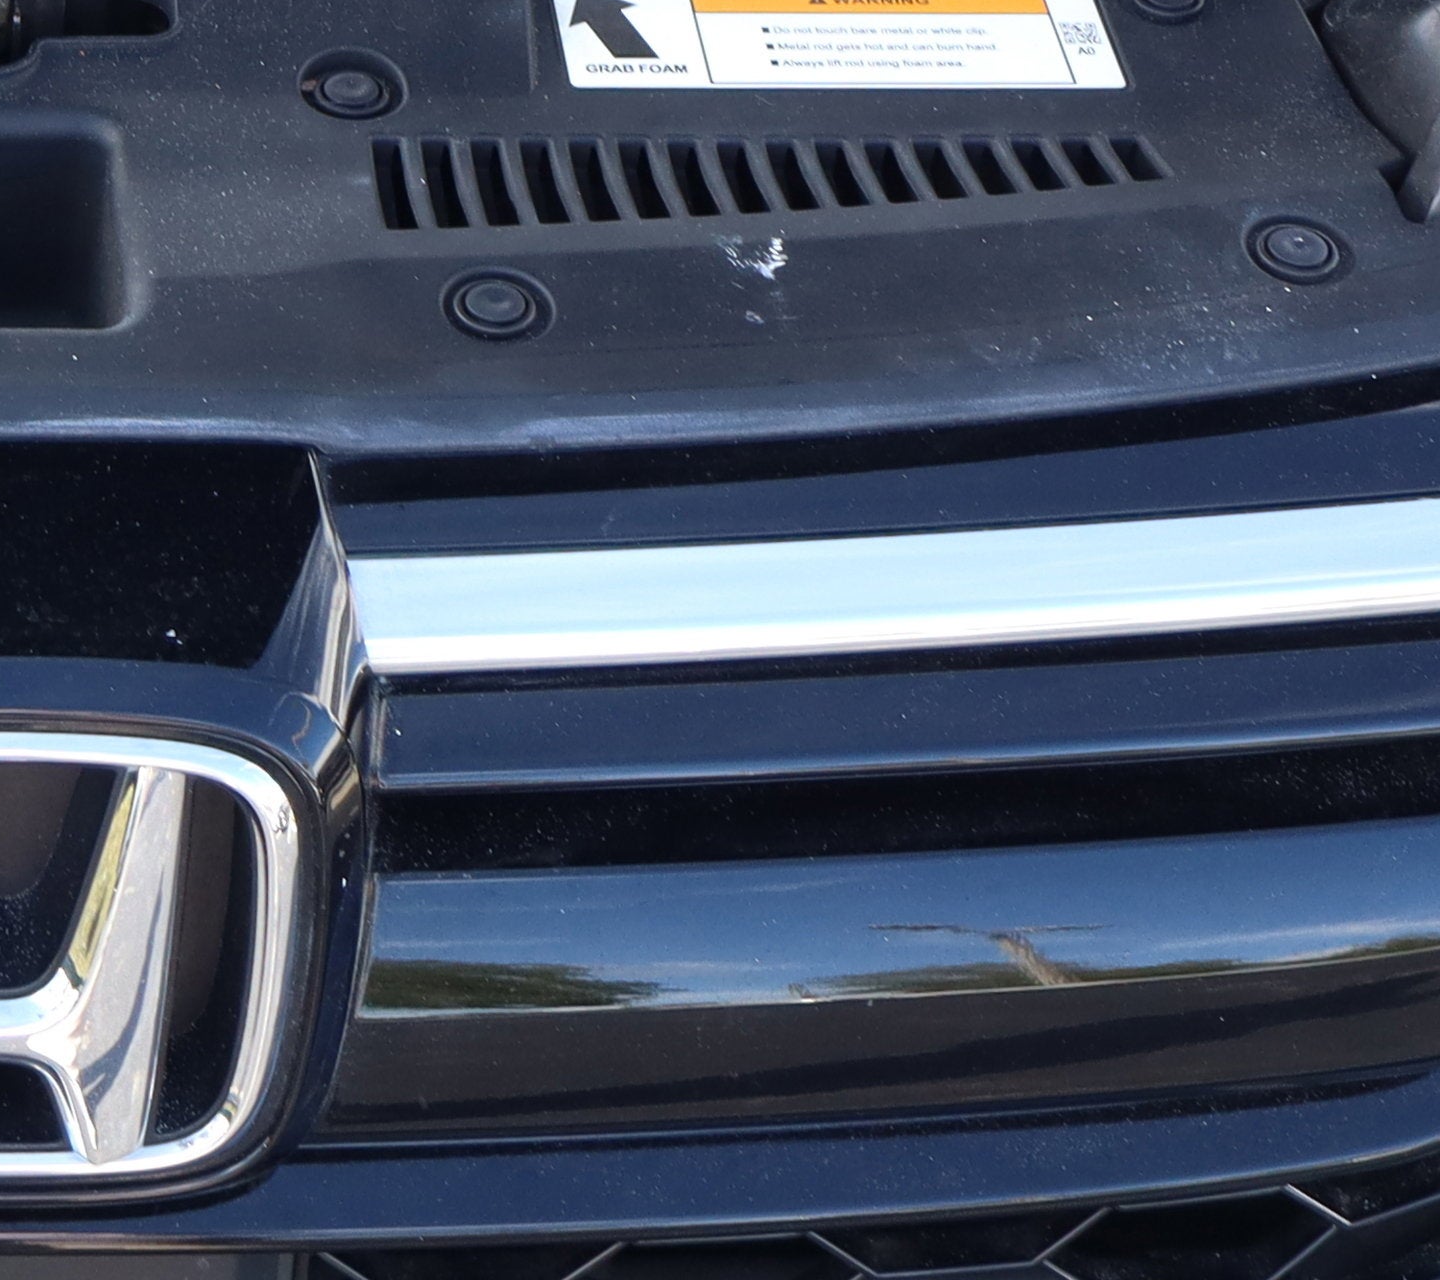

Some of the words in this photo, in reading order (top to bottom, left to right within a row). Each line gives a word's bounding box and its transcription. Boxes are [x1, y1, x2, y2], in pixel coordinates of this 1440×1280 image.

[773, 26, 789, 34] Do
[794, 26, 812, 34] not
[815, 26, 847, 34] touch
[850, 26, 876, 34] bare
[881, 26, 913, 35] metal
[931, 27, 962, 35] white
[778, 43, 810, 51] Metal
[814, 43, 833, 51] rod
[837, 43, 860, 53] gets
[864, 43, 884, 51] hot
[886, 43, 908, 52] and
[912, 44, 933, 52] can
[936, 43, 964, 52] burn
[586, 63, 634, 74] GRAB
[640, 63, 688, 74] FOAM
[783, 59, 824, 69] Always
[827, 59, 842, 67] lift
[845, 59, 864, 67] rod
[867, 59, 899, 70] using
[902, 59, 932, 68] foam
